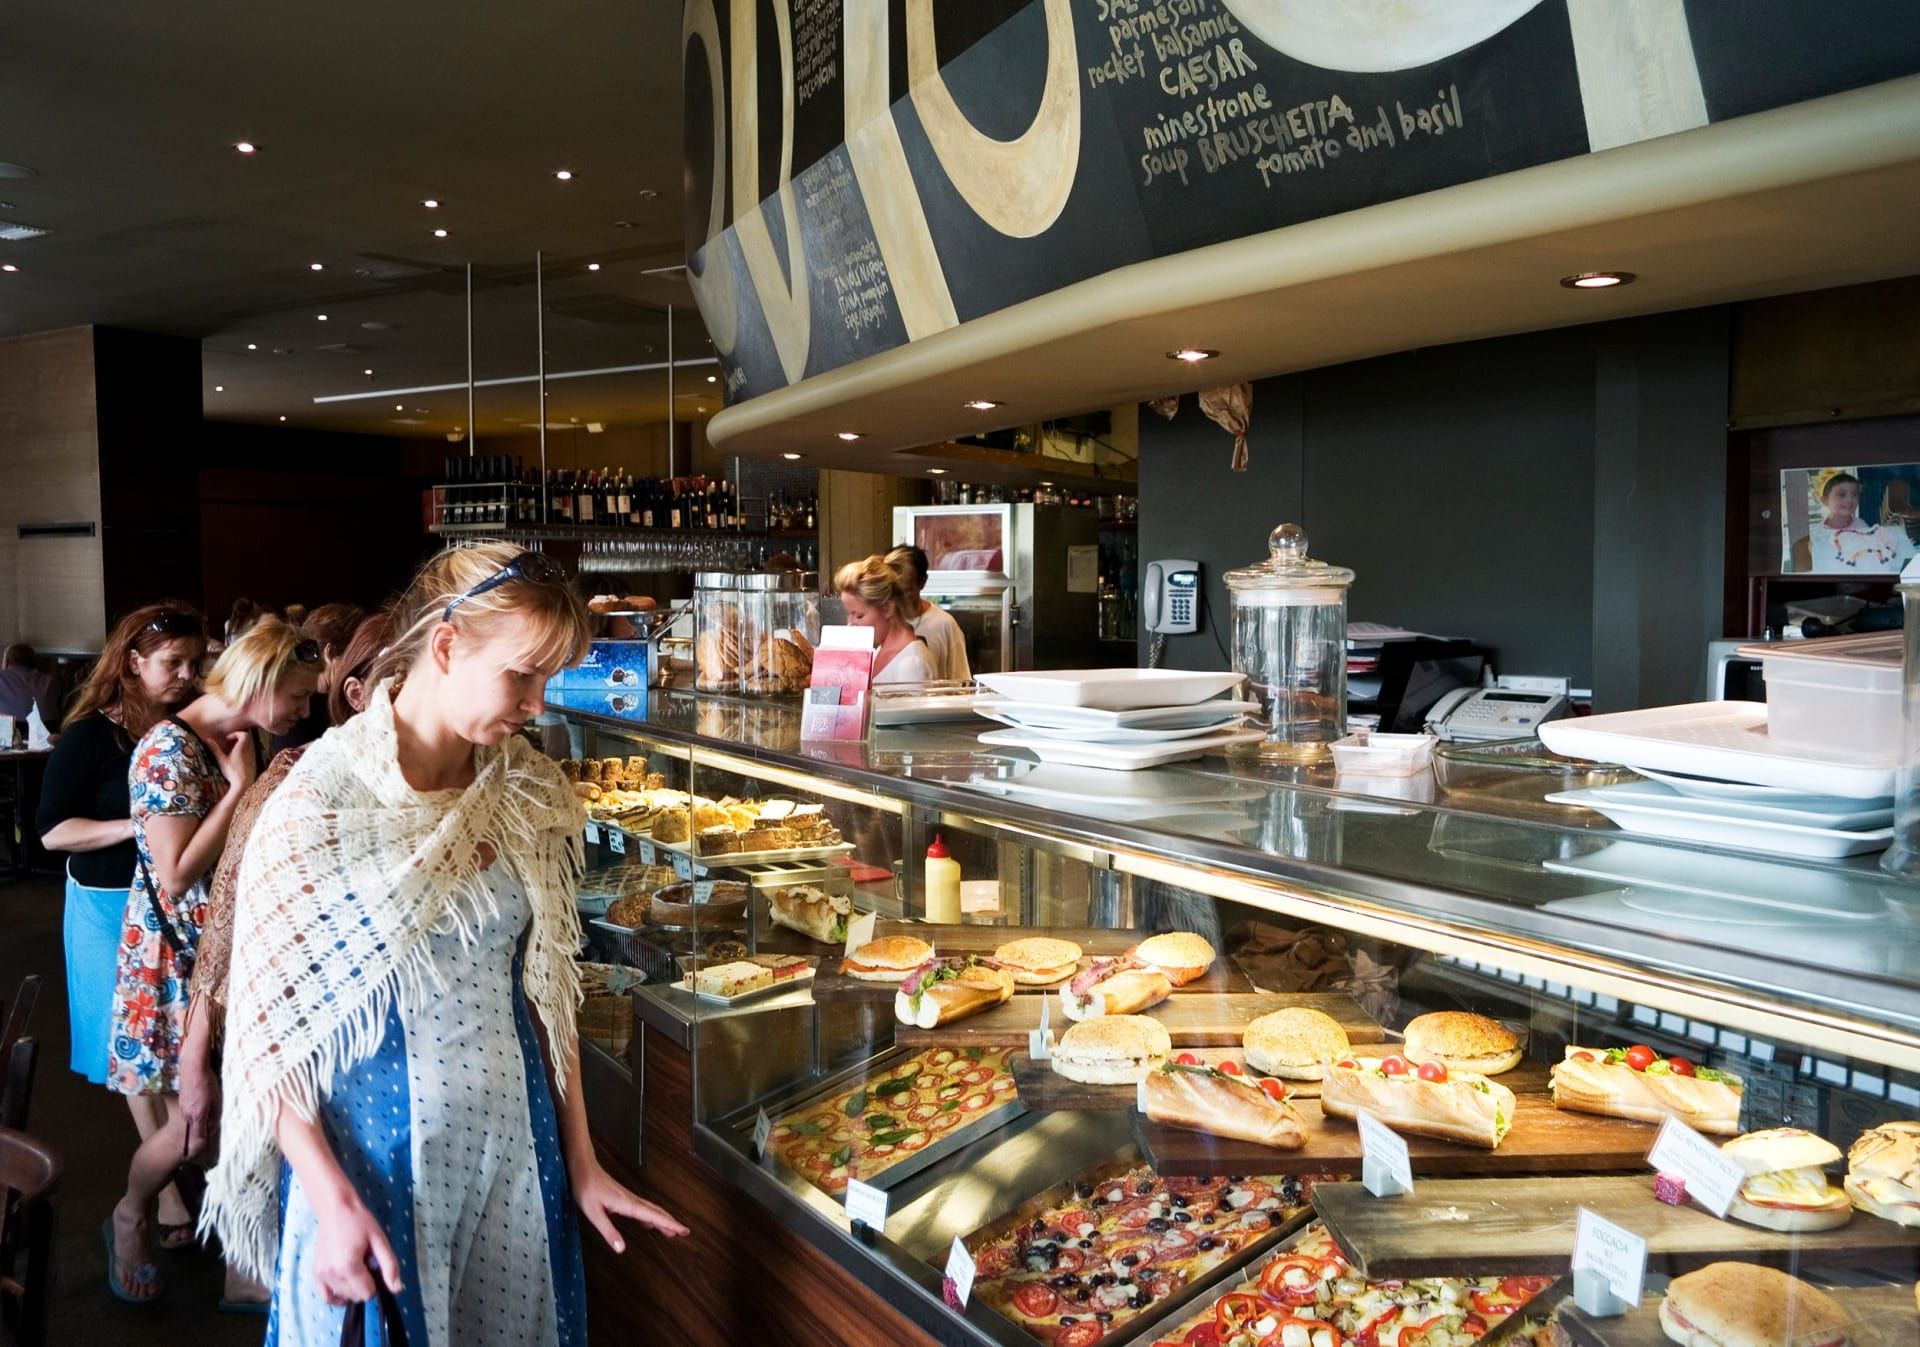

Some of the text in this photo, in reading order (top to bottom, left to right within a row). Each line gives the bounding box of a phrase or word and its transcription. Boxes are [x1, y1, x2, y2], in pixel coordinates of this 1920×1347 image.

[1088, 5, 1239, 89] rocket balsamic
[1159, 38, 1258, 99] CAESAR
[1141, 94, 1355, 187] soup BRUSCHETTA
[1143, 82, 1273, 150] minestrone
[1256, 84, 1464, 189] tomato and basil
